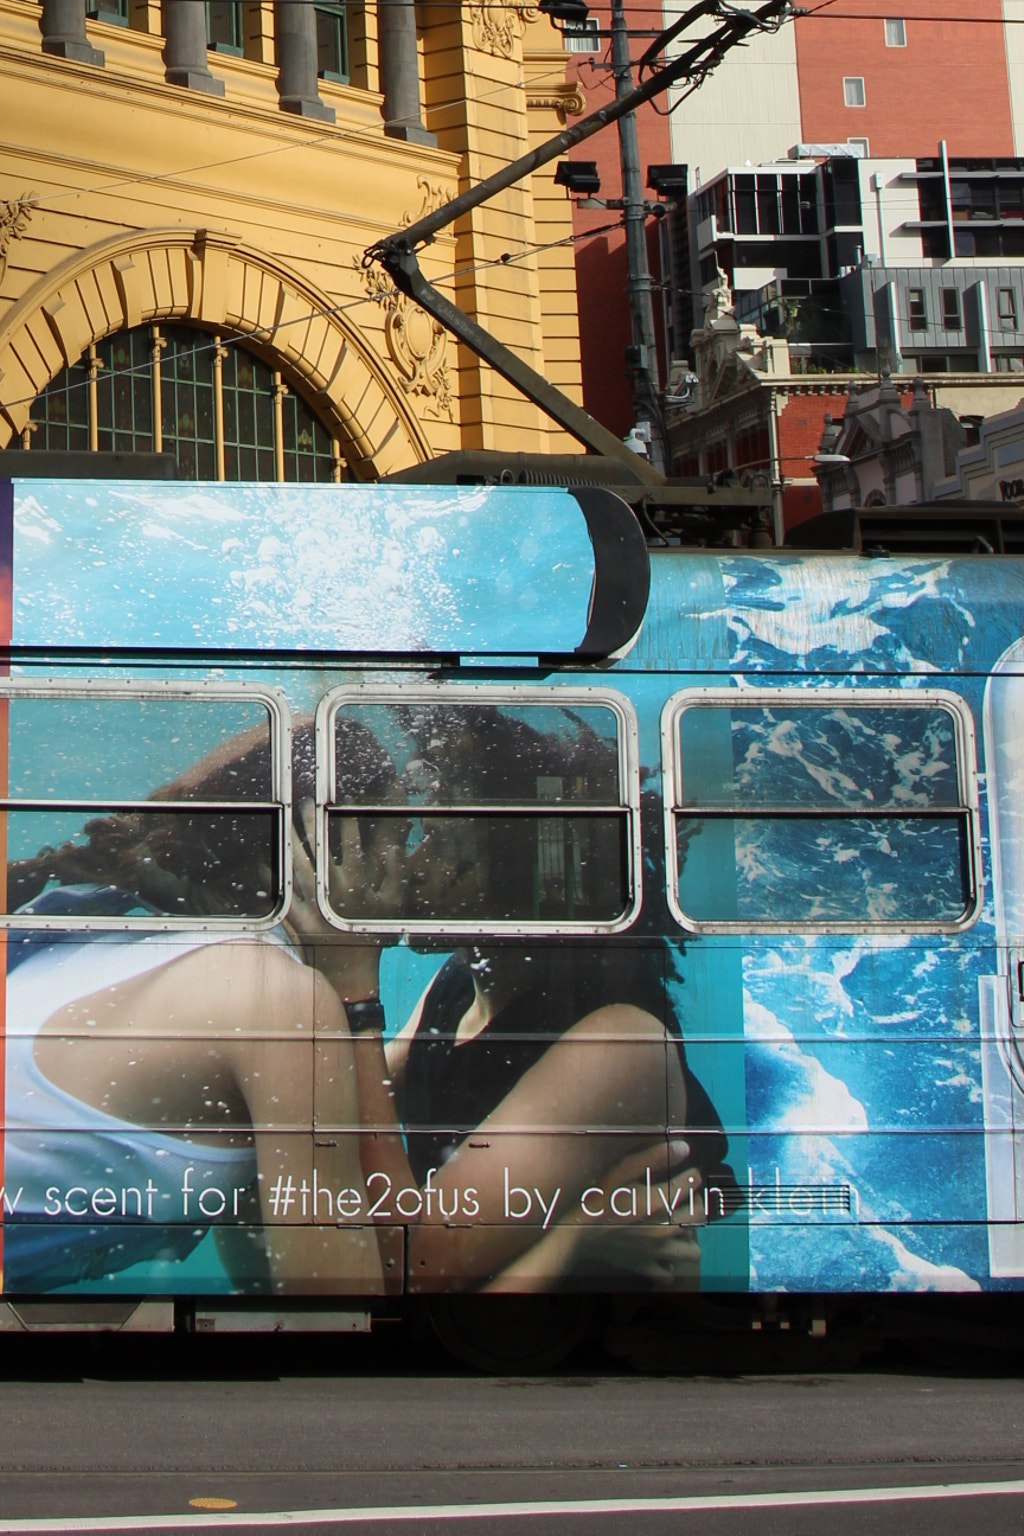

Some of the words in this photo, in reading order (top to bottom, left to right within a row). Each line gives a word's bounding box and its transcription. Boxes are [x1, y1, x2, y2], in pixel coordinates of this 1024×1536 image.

[43, 1179, 159, 1216] scent
[181, 1167, 246, 1216] for
[268, 1168, 480, 1217] #the2ofus
[504, 1166, 561, 1230] by
[580, 1166, 725, 1217] calvin
